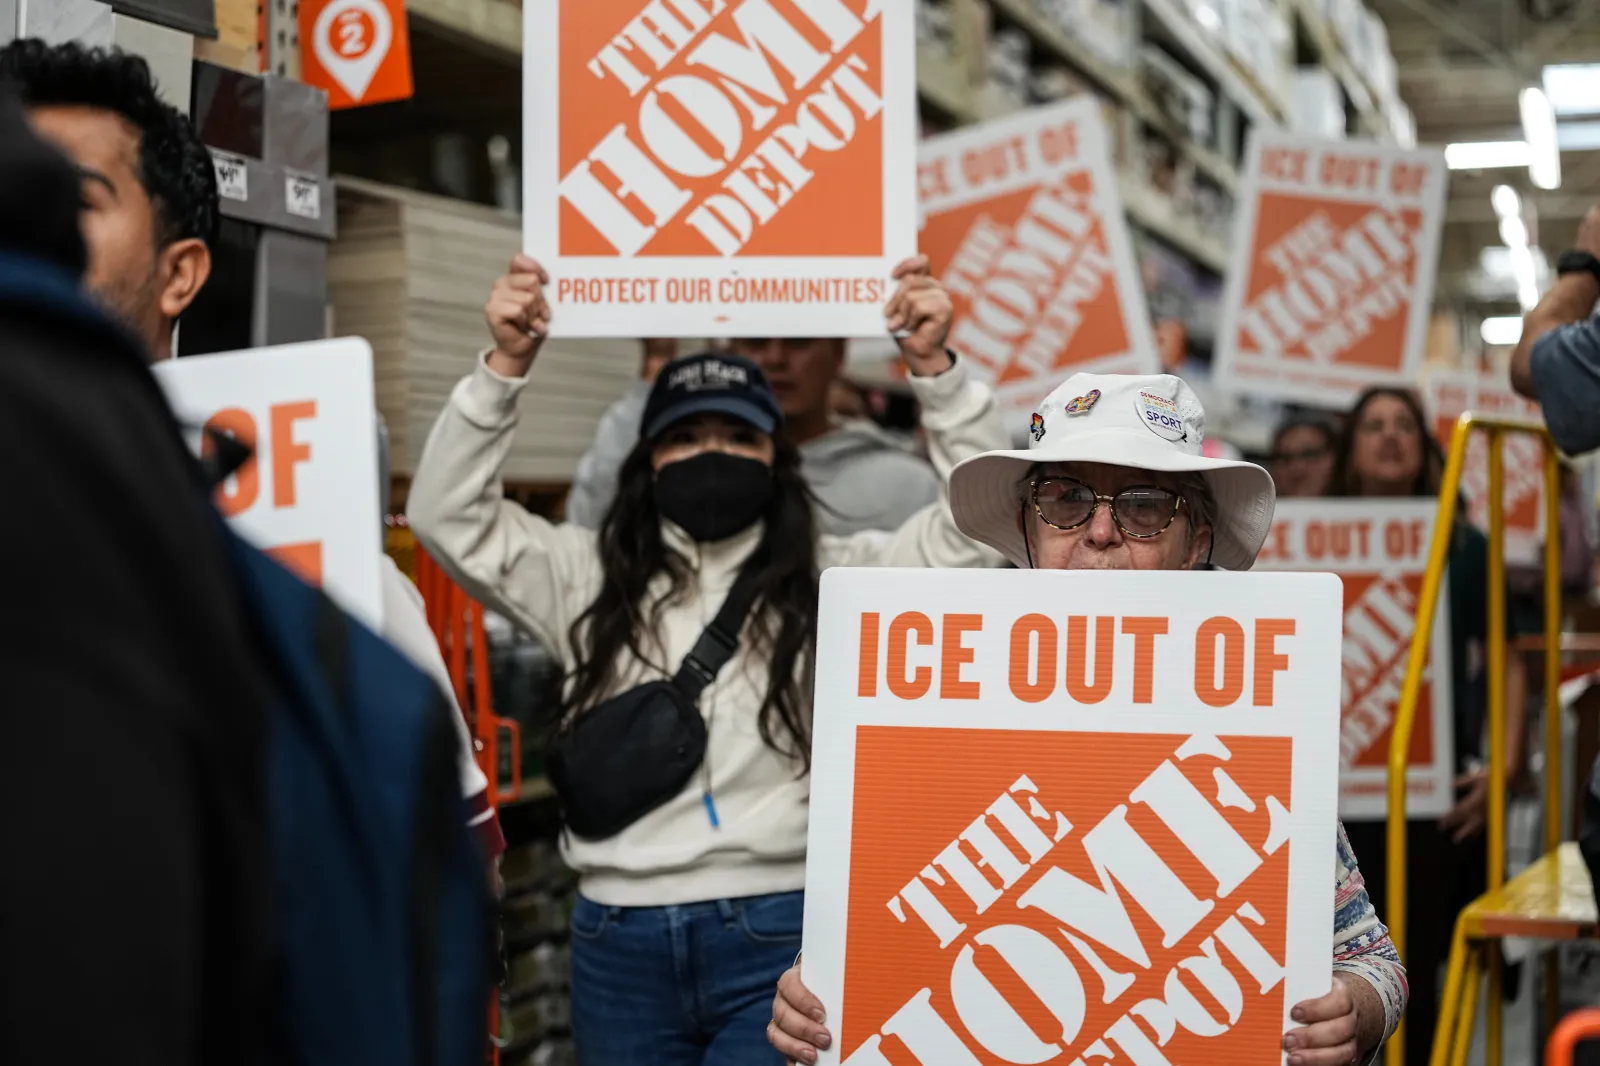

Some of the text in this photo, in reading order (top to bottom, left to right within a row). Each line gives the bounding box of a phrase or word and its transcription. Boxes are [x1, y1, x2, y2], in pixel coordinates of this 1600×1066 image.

[339, 22, 366, 54] 2
[685, 55, 885, 258] DEPOT
[917, 156, 951, 201] CE
[557, 277, 660, 304] PROTECT
[665, 277, 712, 304] OUR
[1146, 410, 1182, 431] SPORT
[200, 400, 317, 519] OF
[1305, 520, 1372, 561] OUT
[1383, 520, 1425, 560] OF
[857, 610, 1297, 708] ICE OUT OF
[886, 773, 1075, 950] THE
[1069, 901, 1286, 1066] POT
